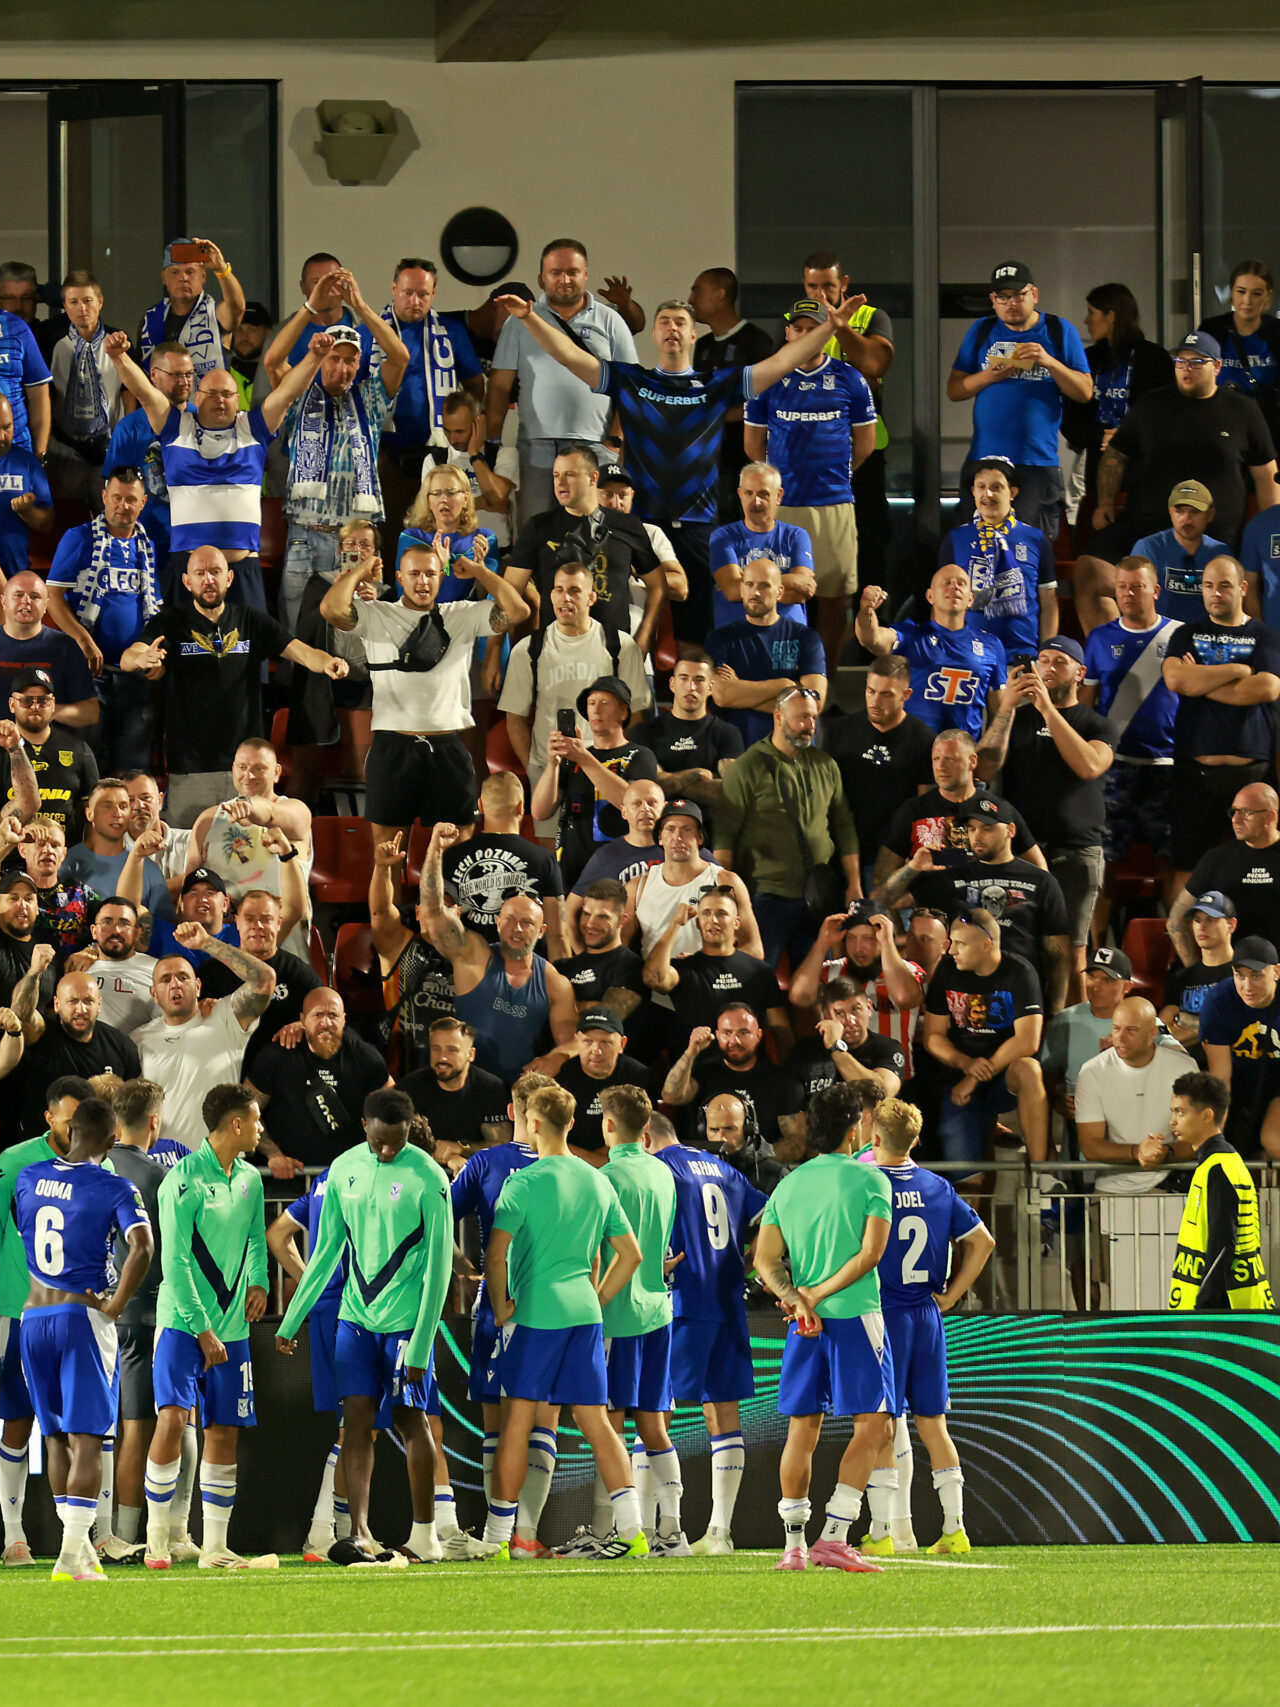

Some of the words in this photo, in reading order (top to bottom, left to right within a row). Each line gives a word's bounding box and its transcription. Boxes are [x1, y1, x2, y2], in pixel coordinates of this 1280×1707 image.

[638, 387, 708, 406] SUPERBET
[776, 410, 841, 423] SUPERBET
[924, 667, 980, 705] STS
[452, 855, 474, 883] LECH
[474, 847, 529, 872] POZNAŃ
[473, 877, 494, 892] WORLD
[495, 877, 502, 888] IS
[493, 997, 527, 1018] BOSS
[687, 1160, 724, 1178] ISHAK
[35, 1178, 73, 1201] OUMA
[895, 1190, 926, 1209] JOEL
[702, 1183, 730, 1250] 9
[35, 1205, 65, 1276] 6
[898, 1215, 930, 1285] 2
